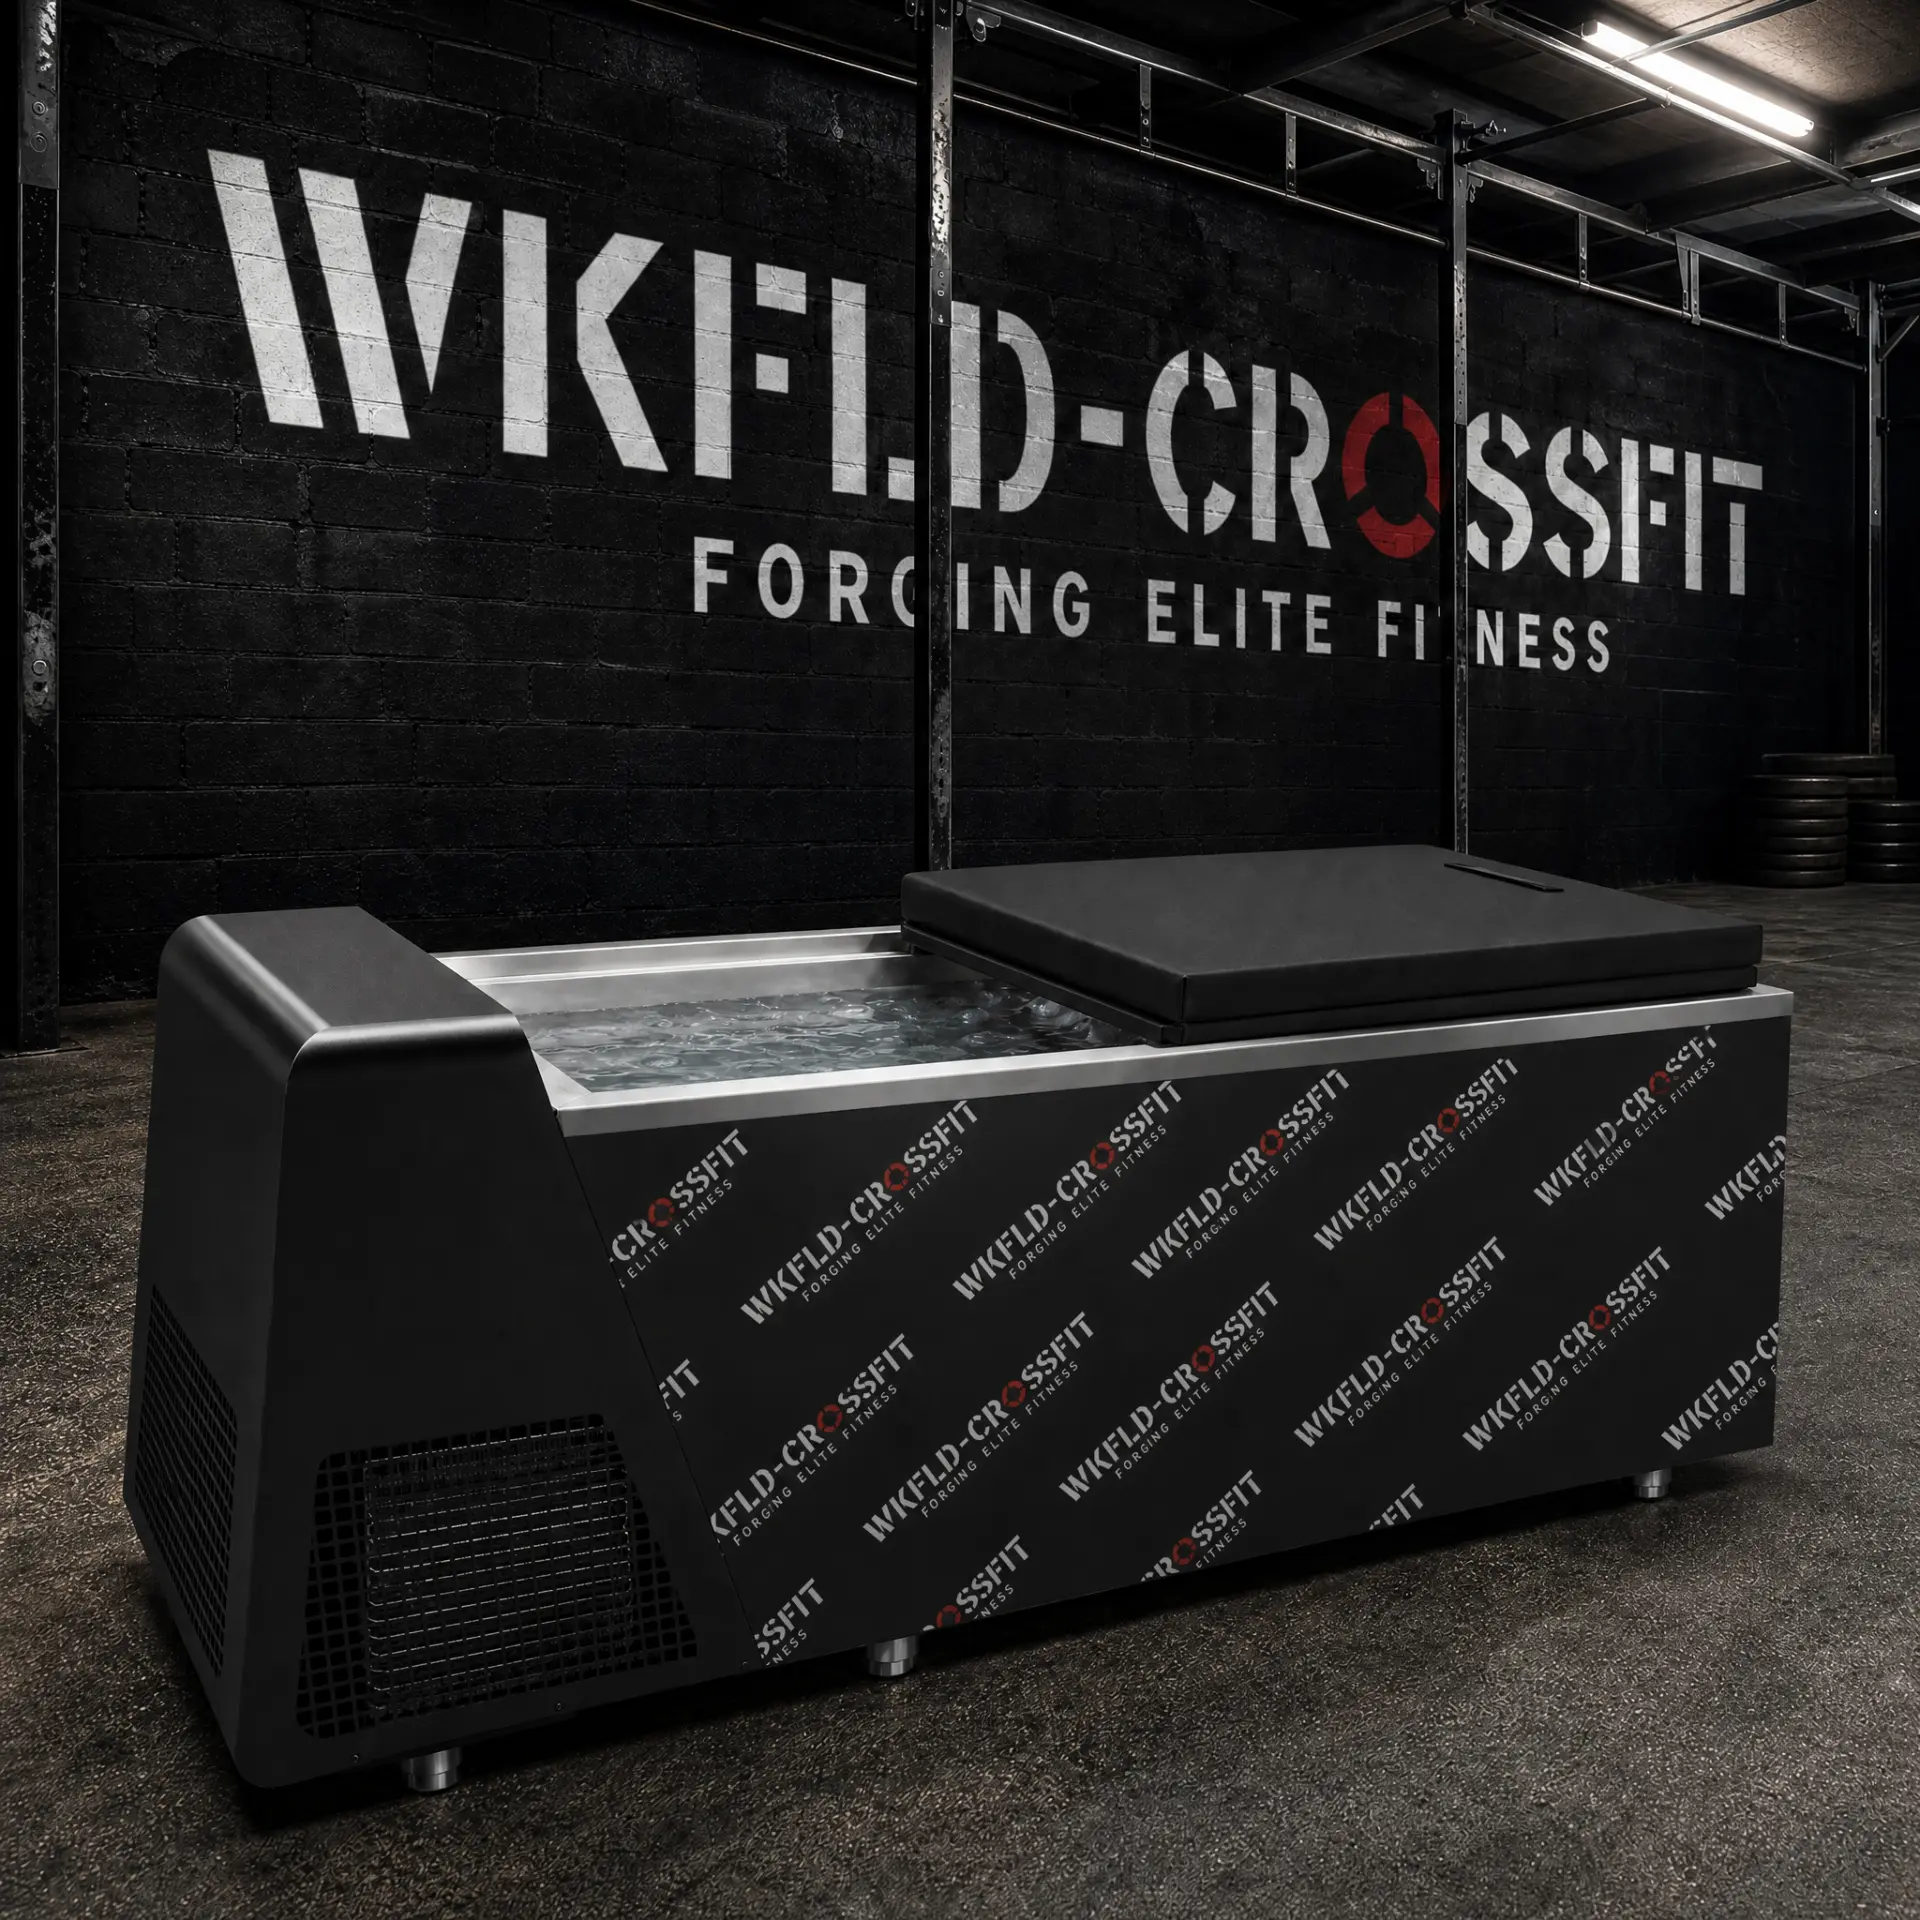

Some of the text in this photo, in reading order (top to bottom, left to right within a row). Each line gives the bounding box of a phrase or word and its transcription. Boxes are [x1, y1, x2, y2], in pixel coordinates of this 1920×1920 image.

[207, 149, 1763, 596] WKFLD-CROSSFIT
[1148, 579, 1332, 655] ELITE
[1378, 600, 1610, 673] FINESS
[953, 1080, 1181, 1300] WKFLD-CROSSFIT
[1132, 1069, 1349, 1278] WKFLD-CROSSFIT
[1243, 1166, 1278, 1202] ELITE
[1283, 1112, 1333, 1163] FITNESS
[1314, 1059, 1518, 1250] WKFLD-CROSSFIT
[1421, 1143, 1455, 1177] ELITE
[1460, 1095, 1505, 1140] FITNESS
[1584, 1058, 1715, 1188] FORGING ELITE FITNESS
[627, 1179, 732, 1278] ELITE FITNESS
[741, 1100, 977, 1324] WKFLD-CROSSFIT
[802, 1145, 962, 1302] FORGING ELITE FITNESS
[1009, 1125, 1166, 1279] FORGING ELITE FITNESS
[1059, 1281, 1278, 1501] WKFLD-CROSSFIT
[1115, 1328, 1264, 1479] FORGING ELITE FITNESS
[1294, 1236, 1505, 1447] WKFLD-CROSSFIT
[1348, 1282, 1491, 1426] FORGING ELITE FITNESS
[1463, 1246, 1670, 1450] WKFLD-CROSSFIT
[1517, 1291, 1657, 1430] FORGING ELITE FITNESS
[1715, 1377, 1766, 1429] FORGING
[733, 1385, 896, 1546] FORGING ELITE FITNESS
[863, 1311, 1093, 1542] WKFLD-CROSSFIT
[922, 1361, 1077, 1517] FORGING ELITE FITNESS
[766, 1629, 806, 1665] NESS
[923, 1535, 1028, 1631] OSSFIT
[974, 1584, 1013, 1619] NESS
